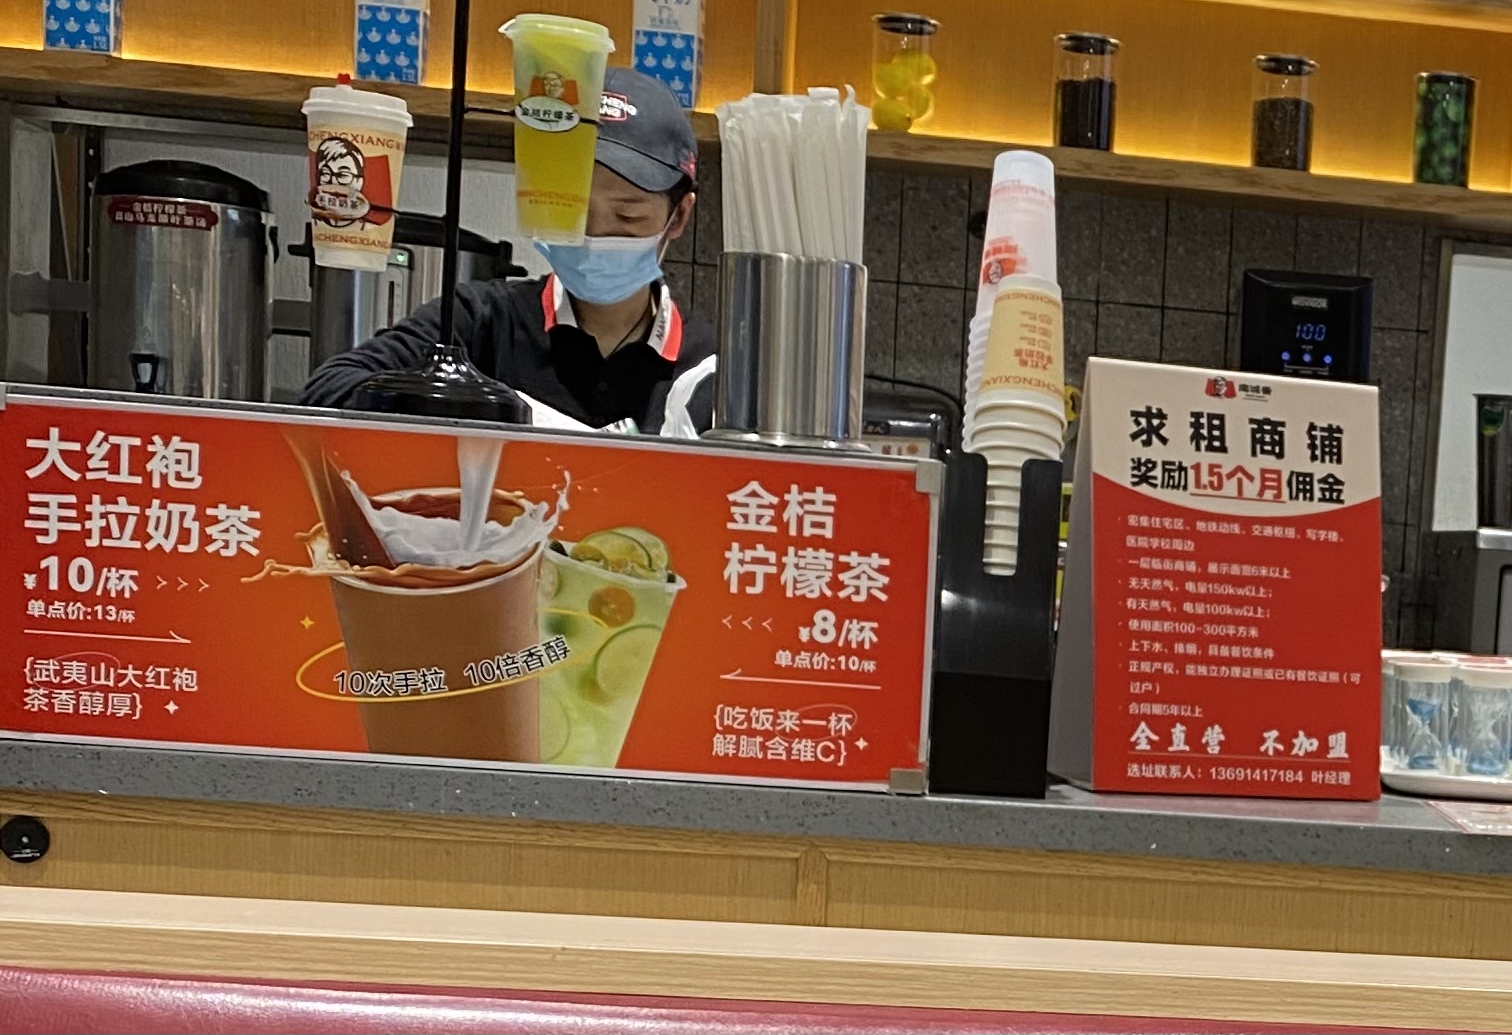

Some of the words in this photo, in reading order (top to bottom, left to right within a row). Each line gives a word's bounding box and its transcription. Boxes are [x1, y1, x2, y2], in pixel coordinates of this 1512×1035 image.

[1296, 324, 1326, 341] 100
[1129, 405, 1344, 465] 求租商铺
[25, 427, 202, 490] 大红袍
[1130, 457, 1345, 505] 奖励1.5个月佣金
[24, 492, 261, 557] 手拉奶茶
[726, 480, 837, 539] 金桔
[24, 554, 139, 598] ¥10/杯
[723, 541, 890, 602] 柠檬茶
[26, 600, 135, 624] 单点价:13/杯
[799, 609, 878, 649] ¥8/杯
[333, 668, 447, 695] 10次手拉
[774, 650, 877, 673] 单点价:10/杯
[1129, 721, 1226, 754] 全直营
[1260, 730, 1349, 758] 不加盟
[1210, 768, 1303, 783] 13691417184
[1311, 770, 1351, 785] 叶经理
